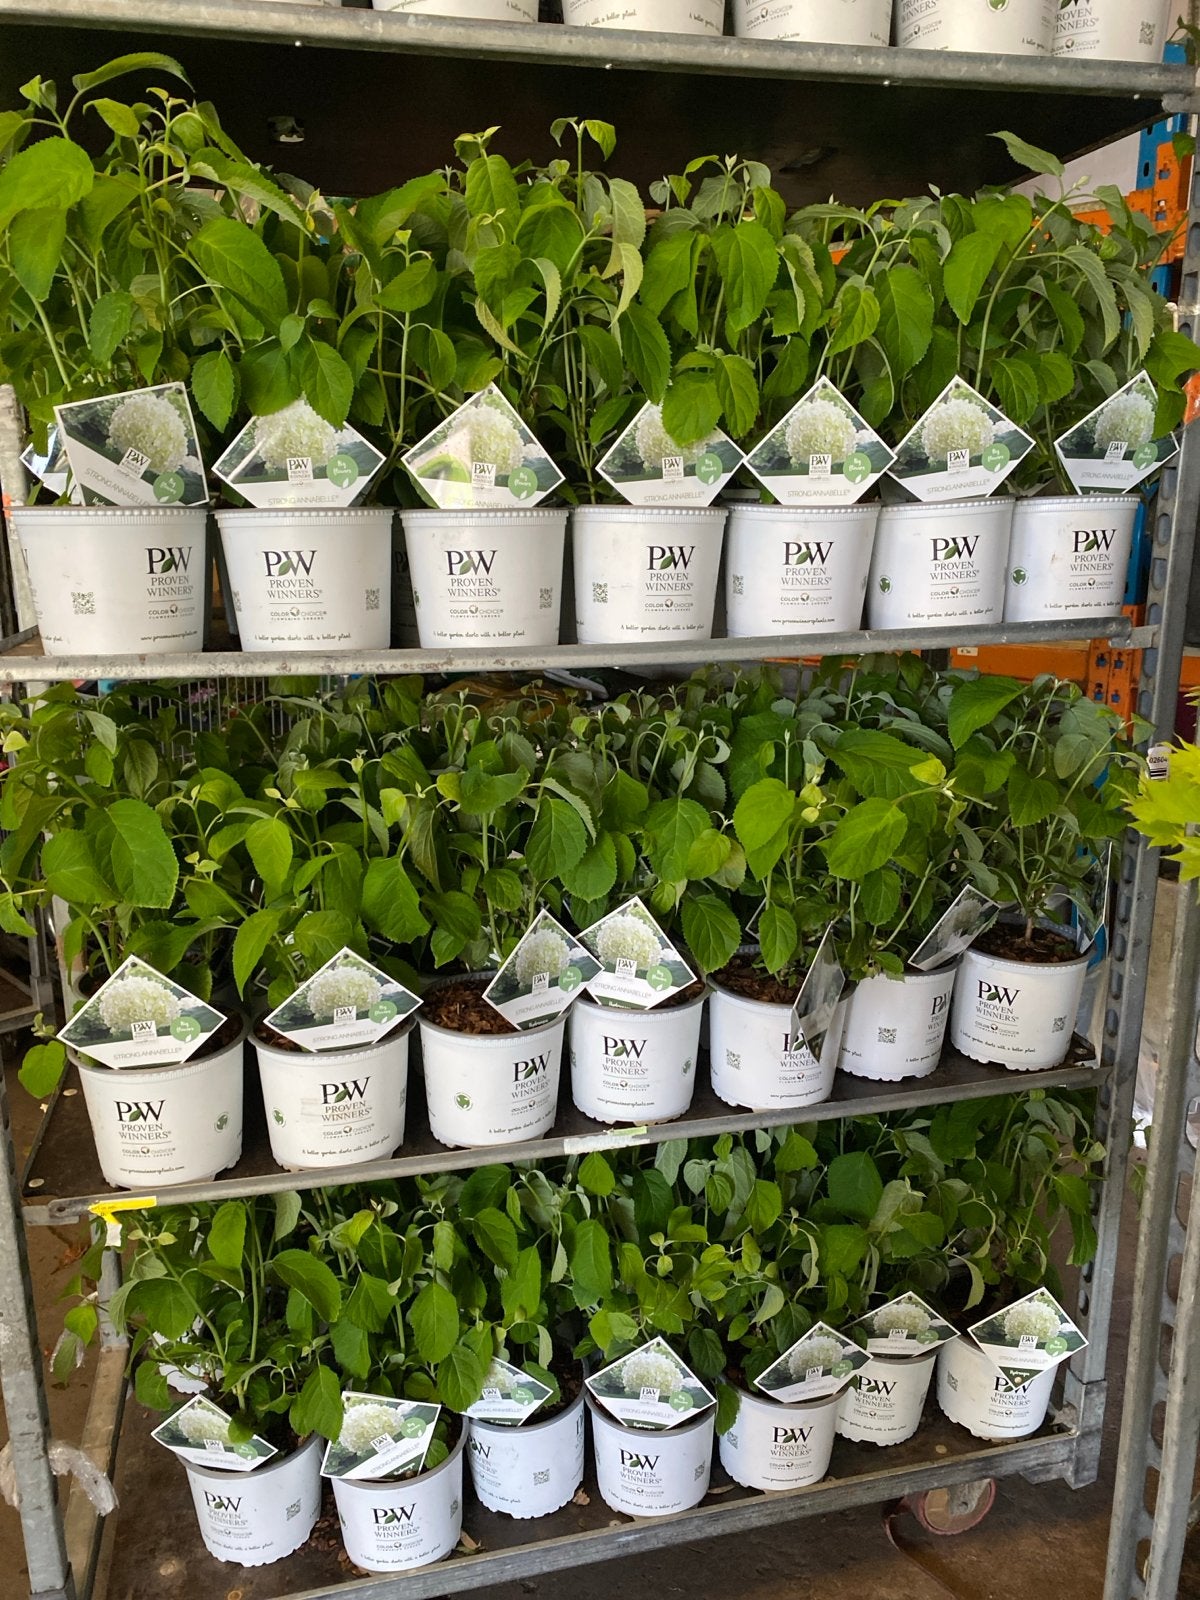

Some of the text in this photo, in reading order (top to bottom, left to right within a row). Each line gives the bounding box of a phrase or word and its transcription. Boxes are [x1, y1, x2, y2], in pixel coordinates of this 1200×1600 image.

[930, 535, 980, 561] PW
[1072, 529, 1117, 553] PW
[145, 546, 192, 574] PW
[262, 550, 318, 576] PW
[444, 550, 498, 575] PW
[647, 546, 695, 570] PW
[782, 542, 834, 565] PW
[1075, 554, 1111, 563] PROVEN
[785, 568, 827, 576] PROVEN
[934, 561, 974, 571] PROVEN
[151, 576, 189, 586] PROVEN
[270, 579, 313, 588] PROVEN
[451, 578, 493, 587] PROVEN
[650, 573, 688, 581] PROVEN
[977, 980, 1020, 1006] PW
[979, 1001, 1014, 1014] PROVEN
[602, 1036, 648, 1059] PW
[513, 1050, 552, 1082] PW
[606, 1058, 642, 1067] PROVEN
[320, 1076, 372, 1104] PW
[516, 1074, 547, 1090] PROVEN
[114, 1100, 166, 1122] PW
[325, 1100, 367, 1113] PROVEN
[859, 1375, 898, 1395] PW
[858, 1392, 891, 1402] PROVEN
[772, 1426, 814, 1443] PW
[619, 1448, 660, 1470] PW
[623, 1467, 656, 1477] PROVEN
[204, 1491, 242, 1512] PW
[371, 1503, 417, 1524] PW
[377, 1522, 414, 1531] PROVEN
